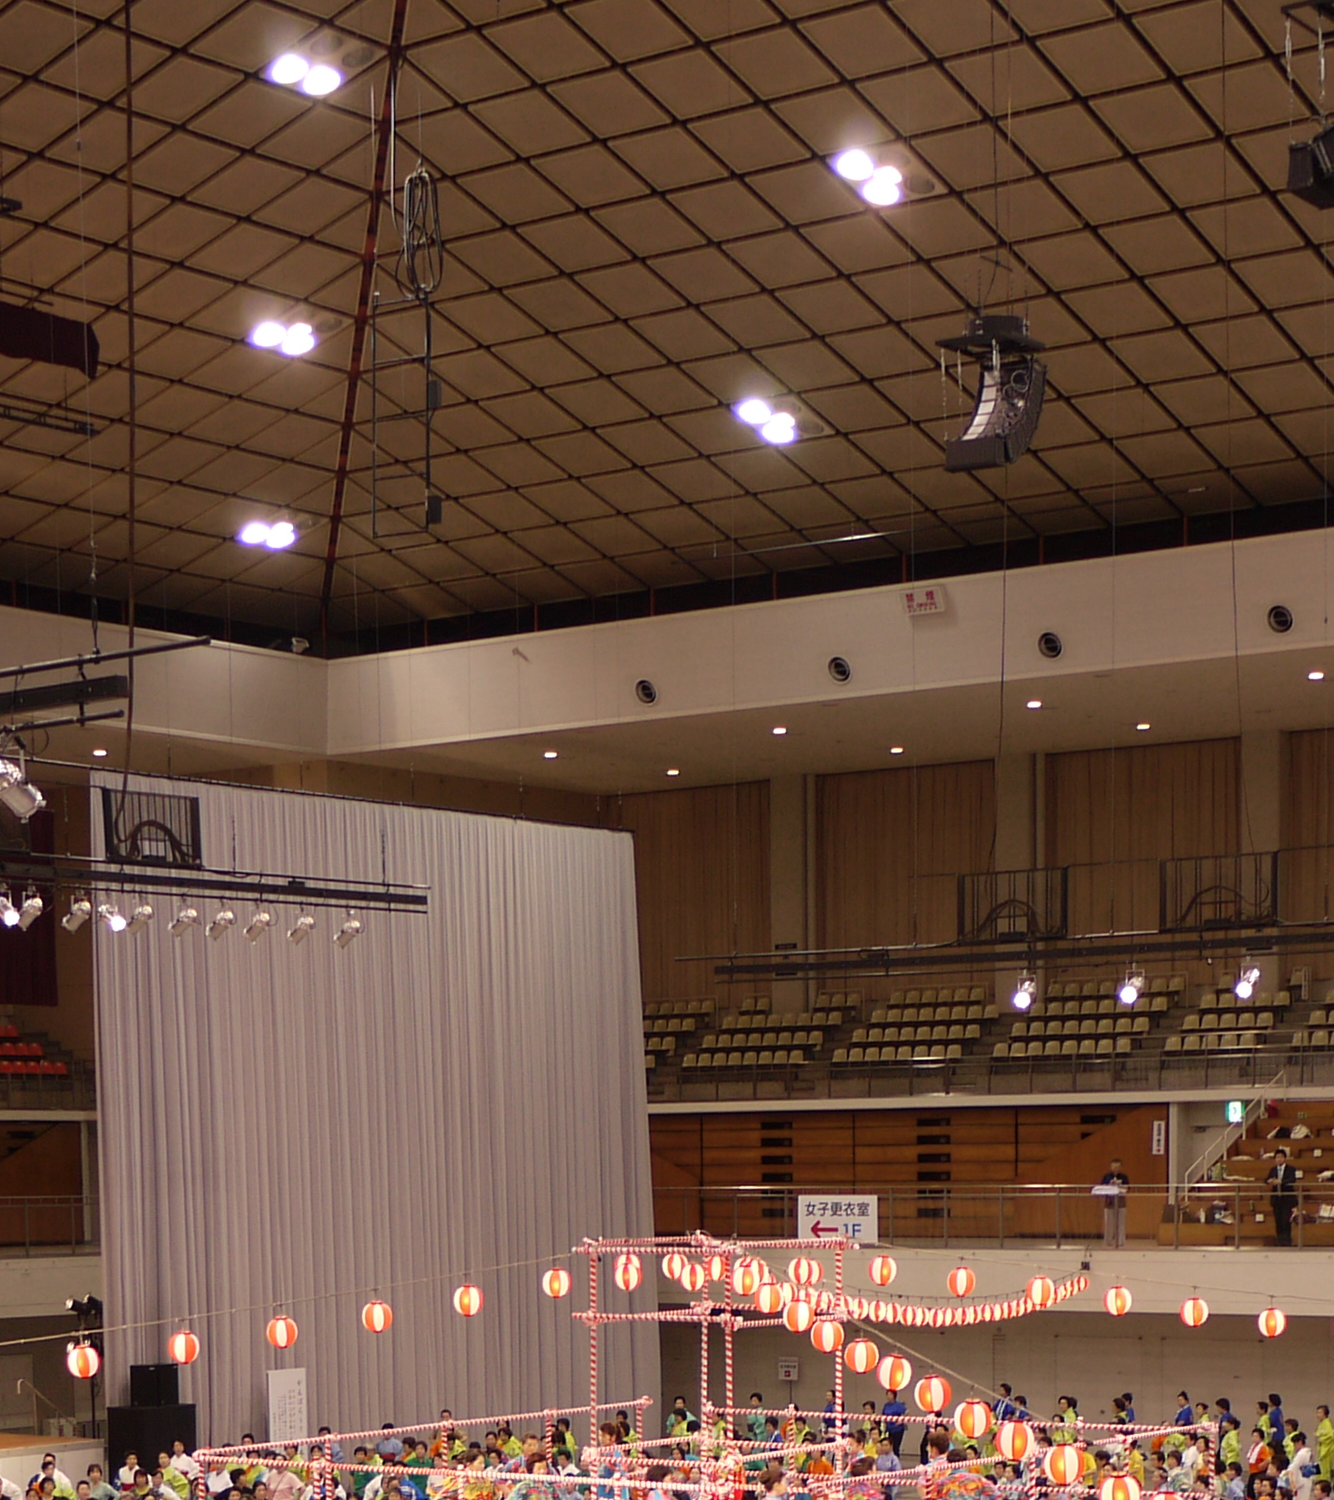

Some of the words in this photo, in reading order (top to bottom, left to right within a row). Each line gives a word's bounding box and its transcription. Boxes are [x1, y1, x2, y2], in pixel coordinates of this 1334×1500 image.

[804, 1201, 870, 1217] 女子更衣室
[843, 1223, 862, 1237] 1F
